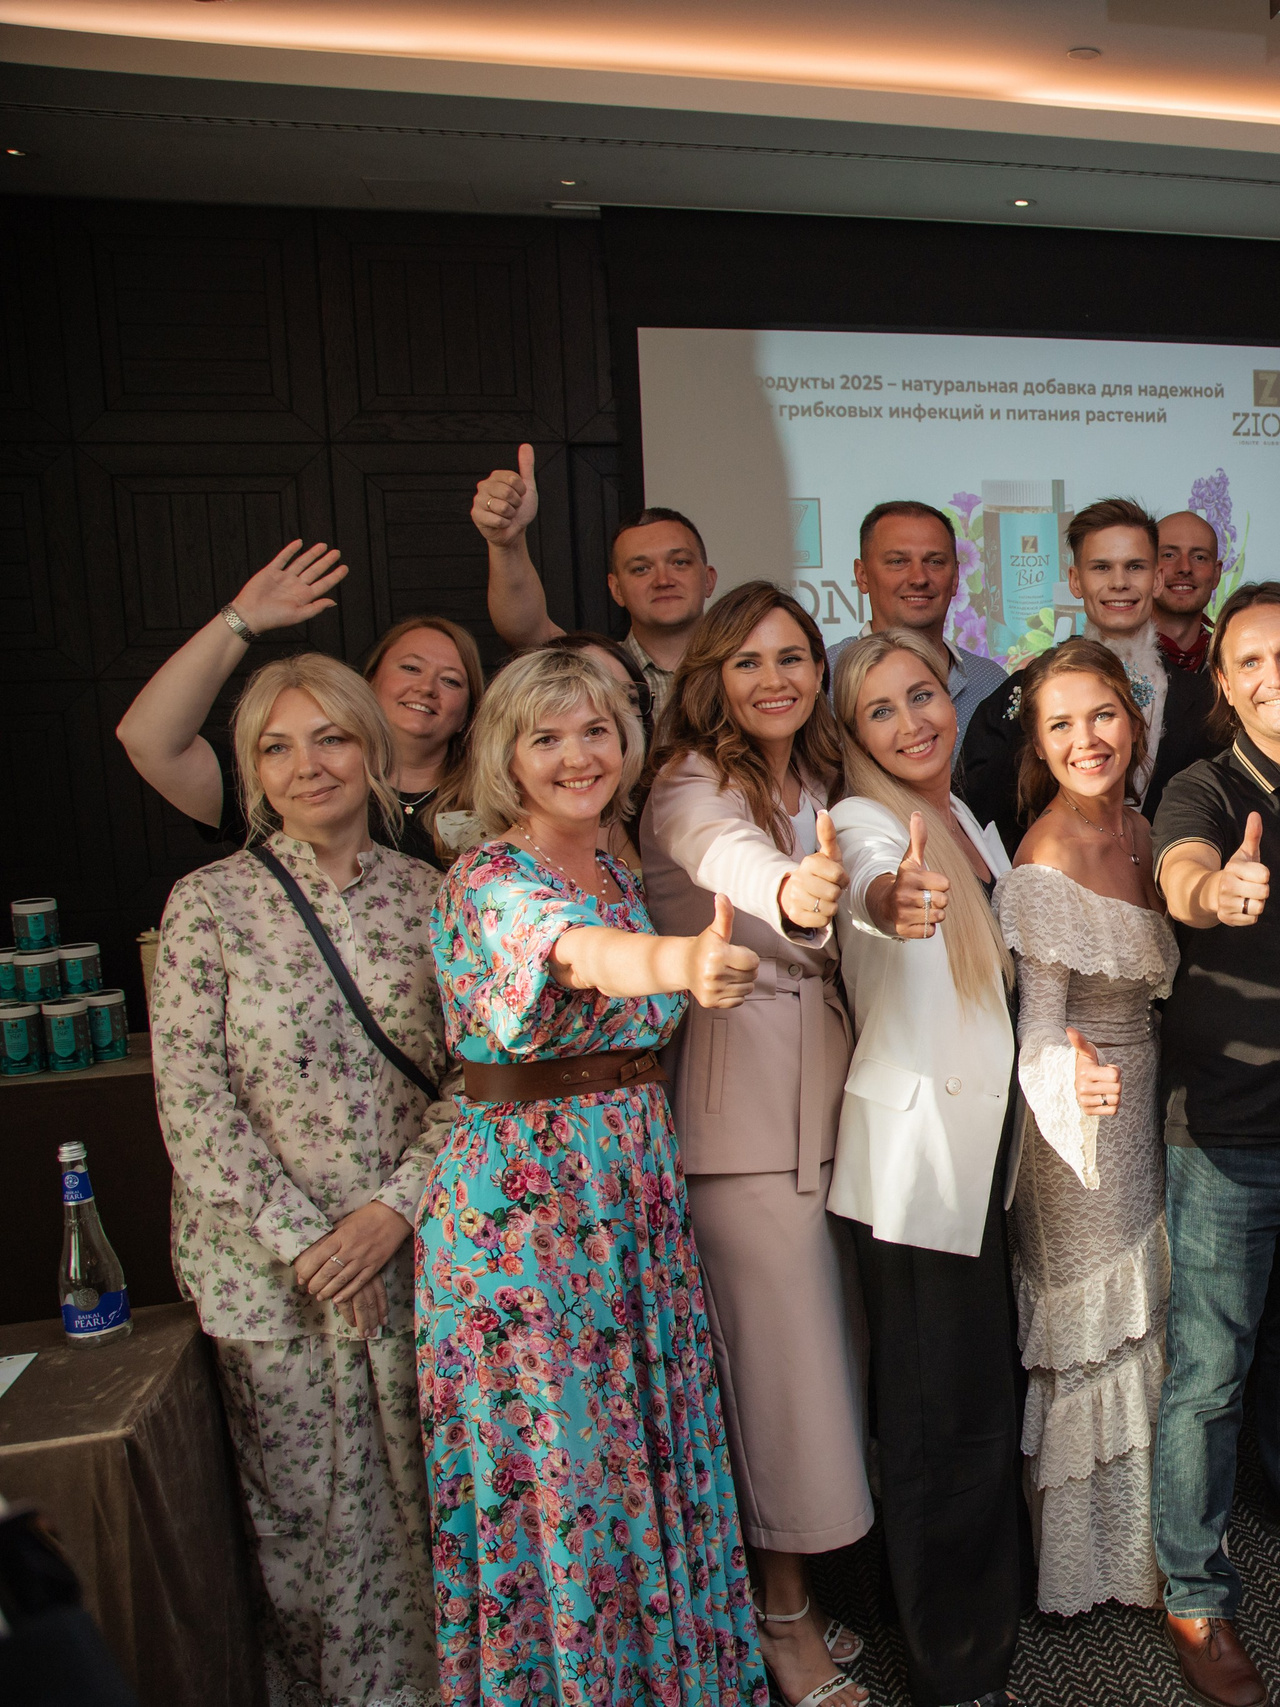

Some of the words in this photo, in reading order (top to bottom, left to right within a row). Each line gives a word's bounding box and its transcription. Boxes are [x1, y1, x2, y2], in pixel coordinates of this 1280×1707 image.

[840, 374, 883, 391] 2025
[901, 377, 1018, 396] натуральная
[1023, 378, 1097, 396] добавка
[1101, 383, 1133, 398] для
[1138, 382, 1224, 399] надежной
[779, 401, 883, 421] грибковых
[889, 403, 984, 422] инфекций
[990, 407, 1001, 420] и
[1006, 407, 1080, 422] питания
[1086, 407, 1167, 425] растений
[1010, 554, 1050, 568] ZION
[1016, 569, 1045, 587] Bio
[74, 1316, 107, 1328] PEARL
[78, 1312, 100, 1320] BAIKAL
